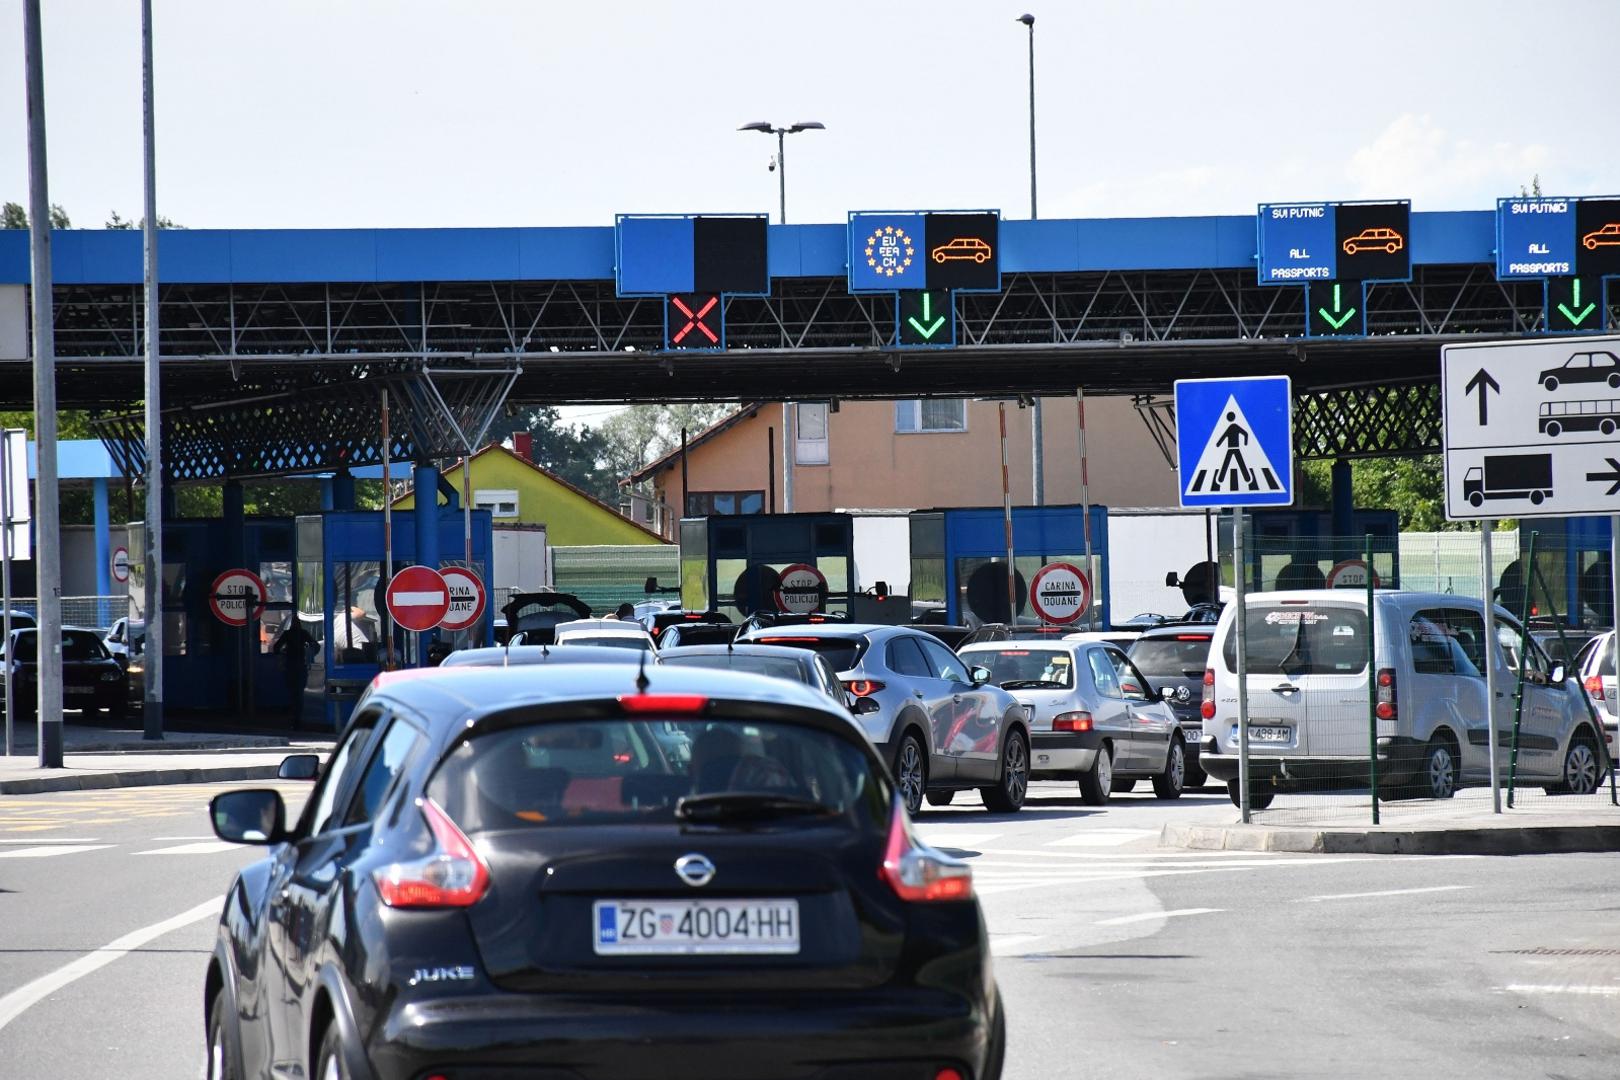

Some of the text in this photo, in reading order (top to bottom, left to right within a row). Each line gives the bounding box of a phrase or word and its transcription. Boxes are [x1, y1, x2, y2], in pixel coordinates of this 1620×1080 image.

[1272, 208, 1288, 218] SVI
[1511, 202, 1568, 214] SVI PUTNICI
[882, 236, 896, 246] EU
[879, 247, 900, 256] EEA
[1289, 248, 1310, 259] ALL
[1528, 243, 1550, 254] ALL
[882, 257, 897, 267] CH
[1271, 267, 1330, 278] PASSPORTS
[1509, 262, 1569, 274] PASSPORTS
[791, 579, 812, 588] STOP
[1045, 580, 1076, 591] CARINA
[227, 585, 248, 594] STO
[449, 586, 471, 595] RINA
[784, 594, 819, 604] POLICIJA
[1043, 596, 1079, 606] DOUANE
[220, 600, 248, 609] POLICI
[449, 602, 473, 611] UANE
[621, 907, 656, 939] ZG
[407, 965, 475, 986] JUKE
